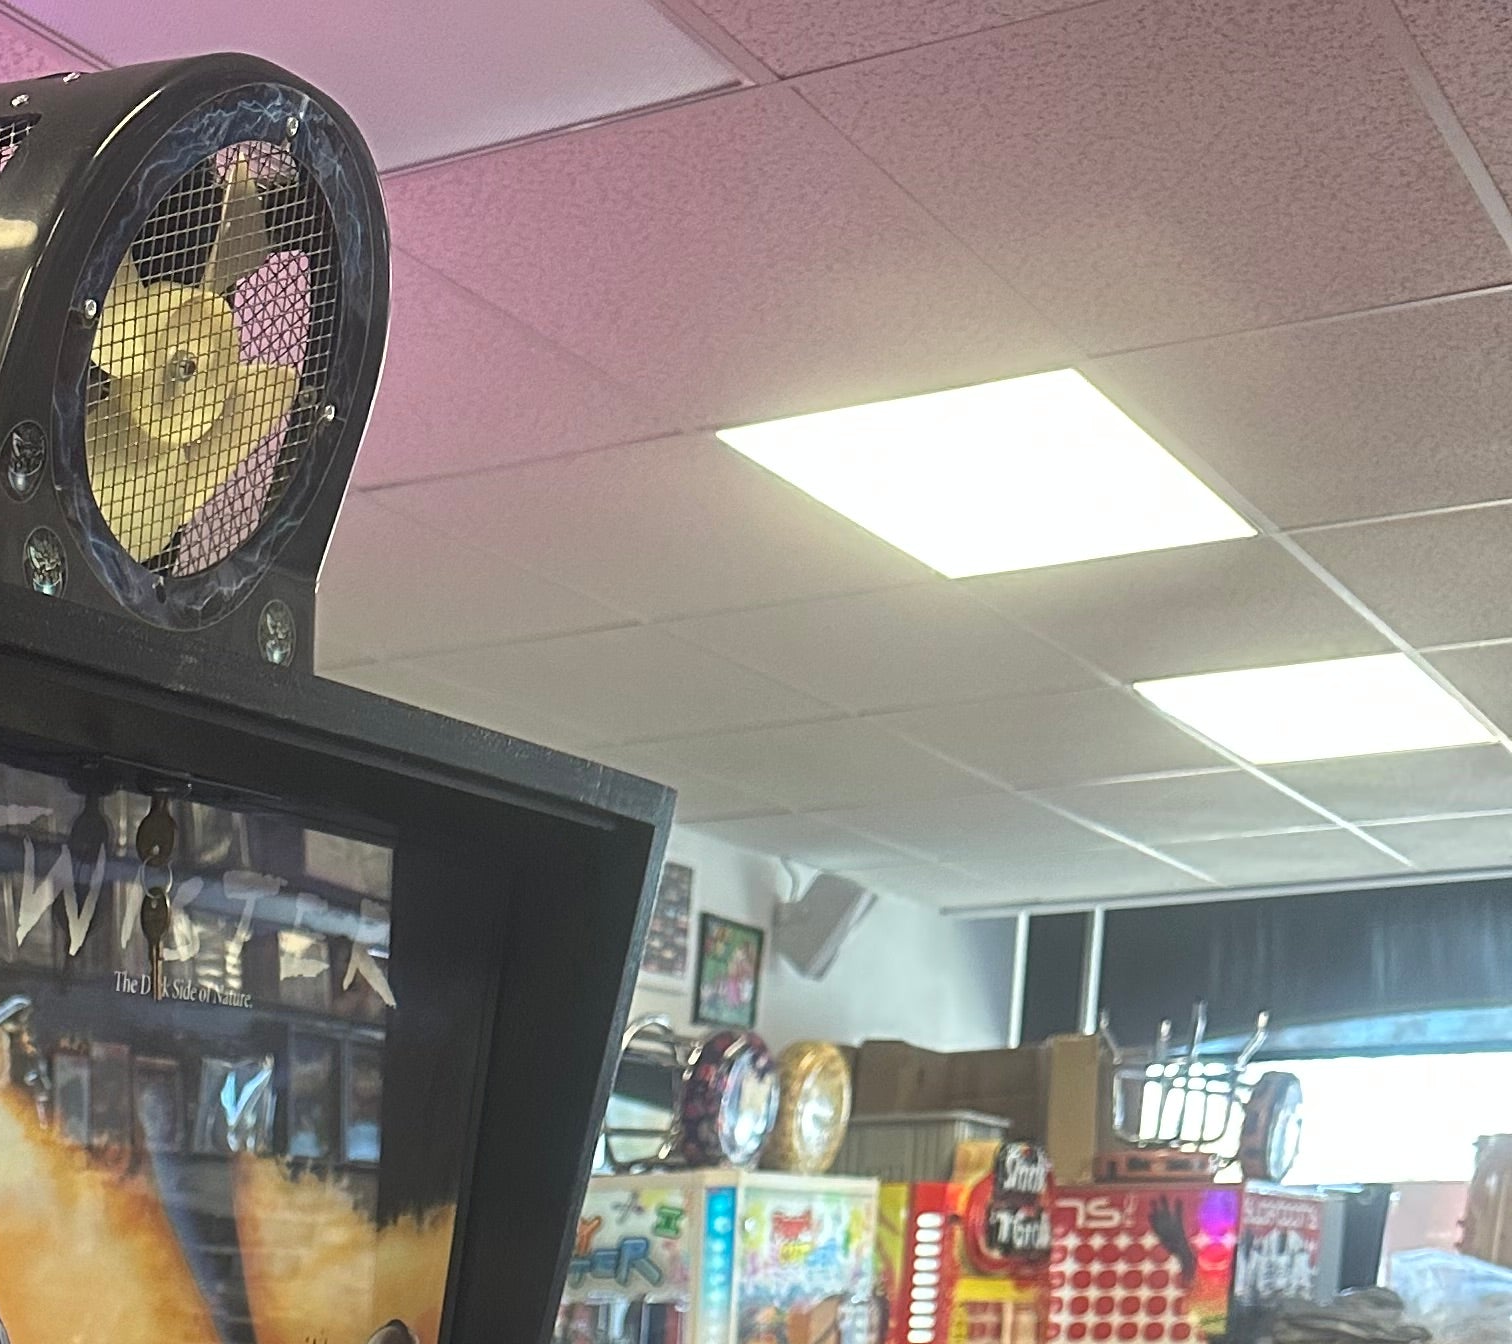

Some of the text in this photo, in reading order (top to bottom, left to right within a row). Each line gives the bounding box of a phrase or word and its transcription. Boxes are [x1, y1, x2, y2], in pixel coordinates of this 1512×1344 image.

[114, 970, 138, 994] The
[140, 973, 170, 998] Dk
[172, 977, 198, 1002] Side
[199, 986, 211, 1004] of
